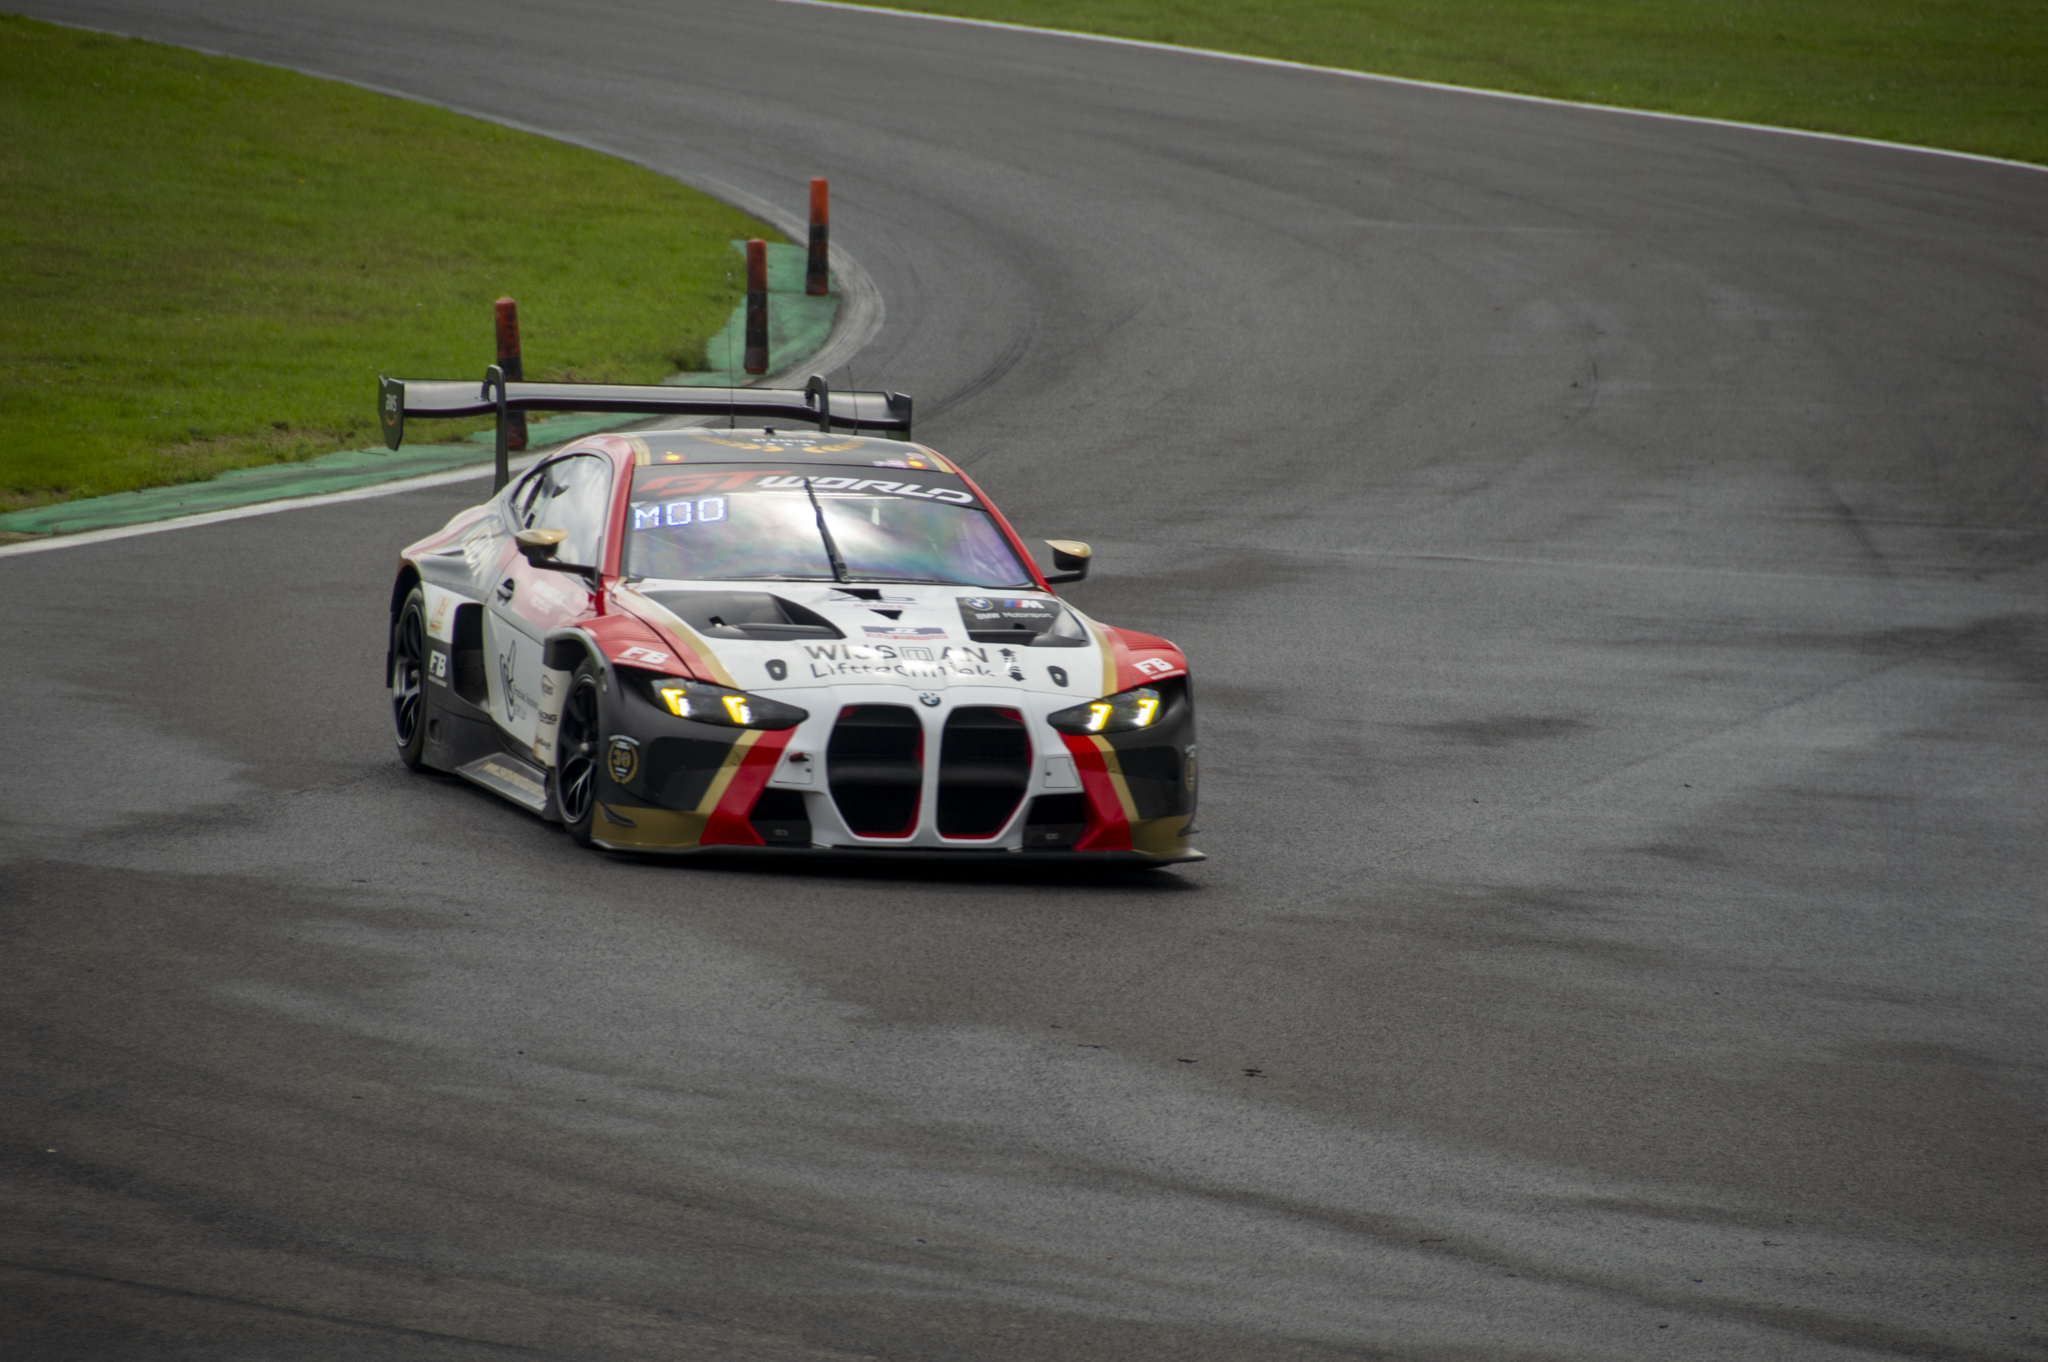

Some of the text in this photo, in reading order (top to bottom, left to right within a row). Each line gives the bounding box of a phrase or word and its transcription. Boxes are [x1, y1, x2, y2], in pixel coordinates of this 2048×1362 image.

[636, 470, 974, 504] GT WORLD
[428, 649, 447, 678] FB
[618, 646, 669, 664] FB
[1132, 657, 1175, 675] FB
